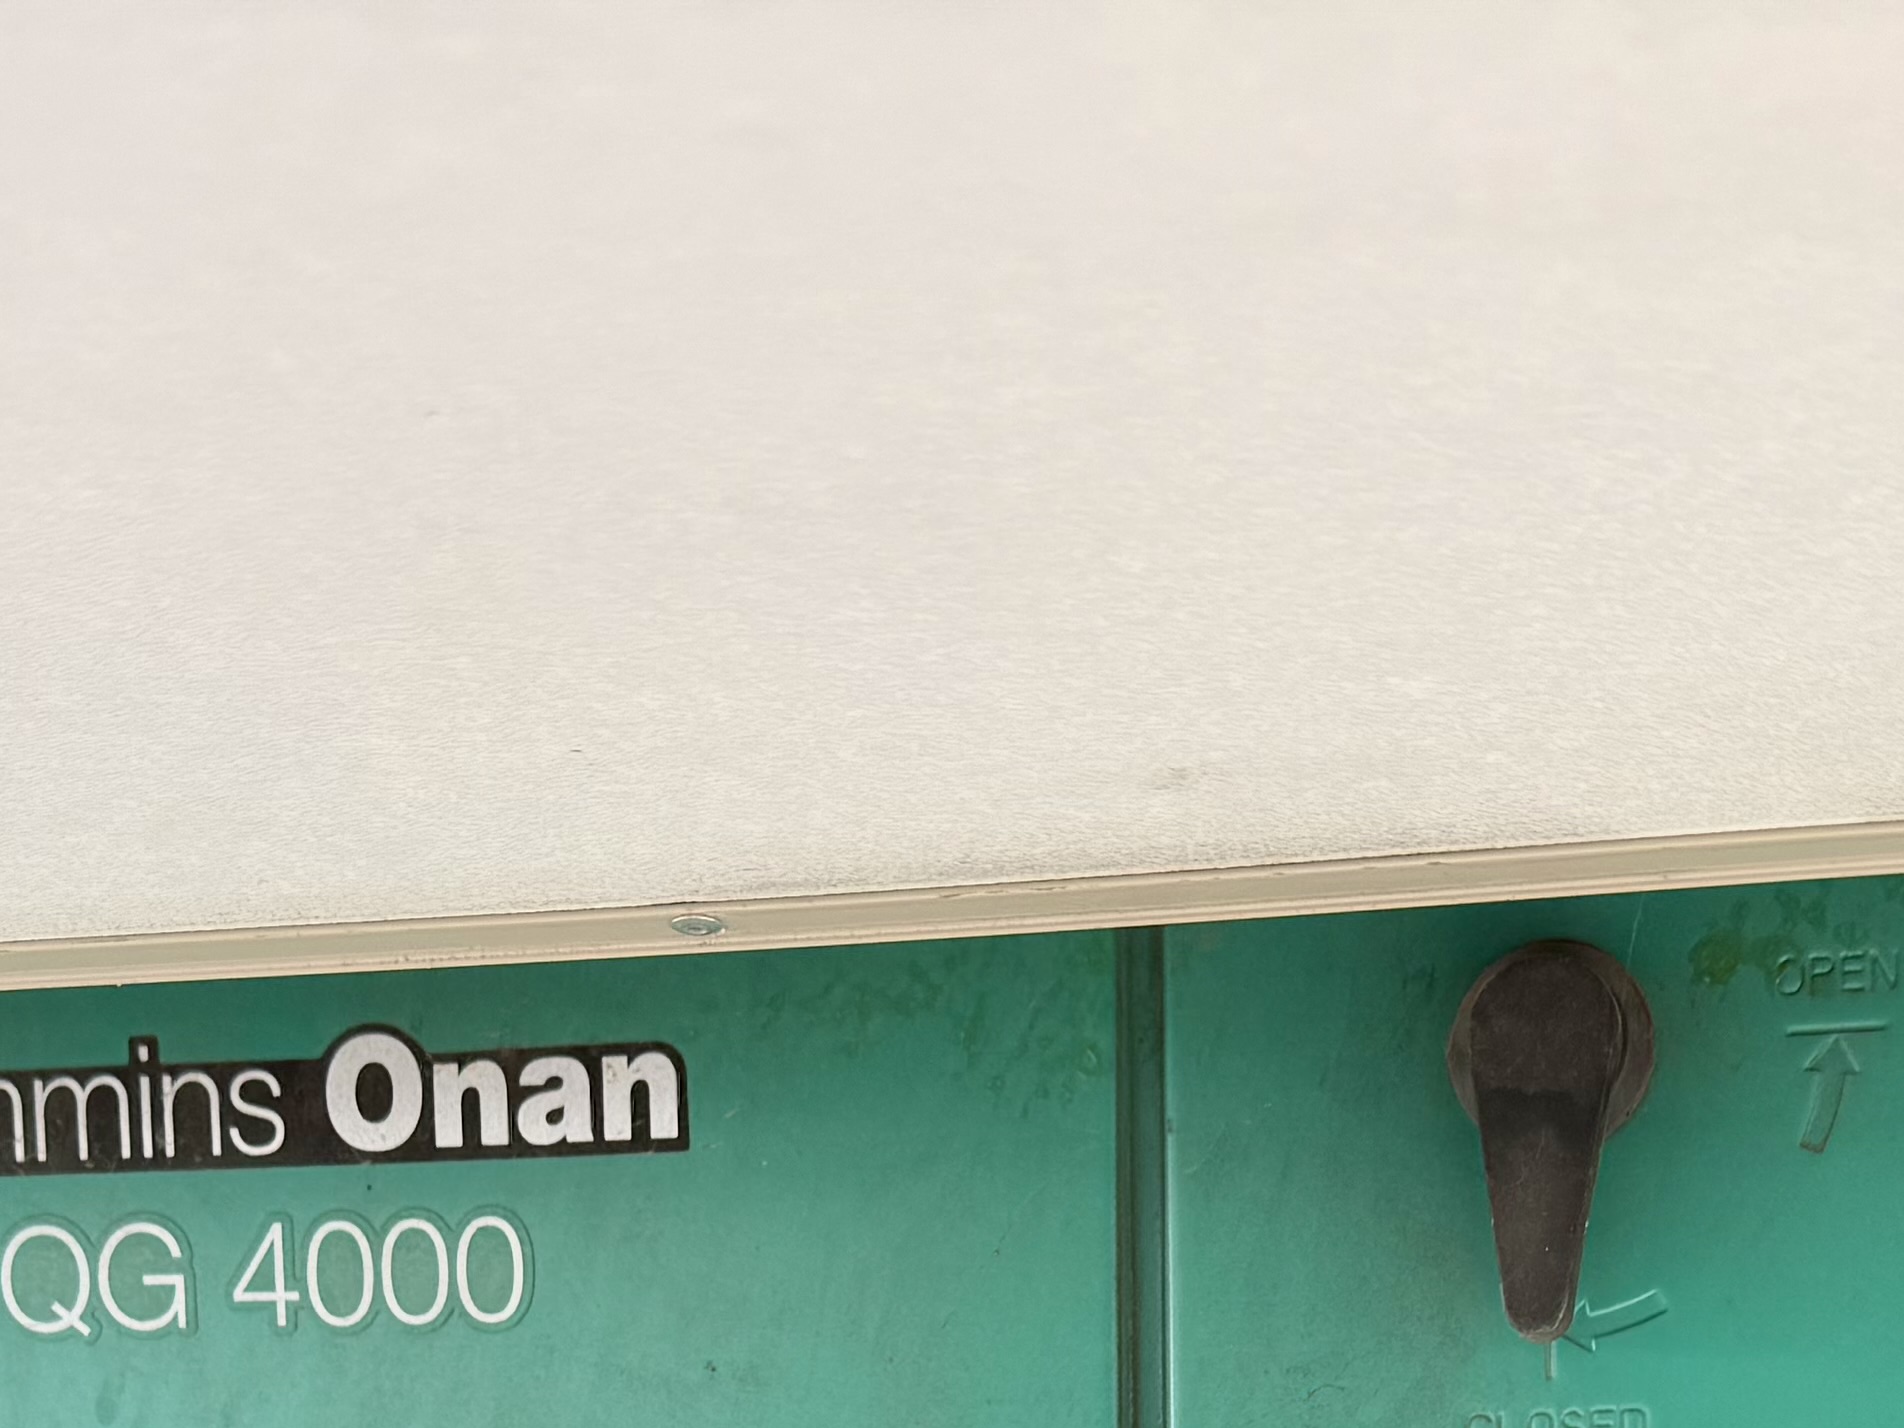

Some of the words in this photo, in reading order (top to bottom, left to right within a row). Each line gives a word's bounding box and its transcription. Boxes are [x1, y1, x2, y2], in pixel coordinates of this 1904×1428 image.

[1776, 948, 1899, 997] OPEN
[325, 1033, 680, 1152] Onan
[0, 1221, 188, 1338] QG
[232, 1215, 524, 1328] 4000
